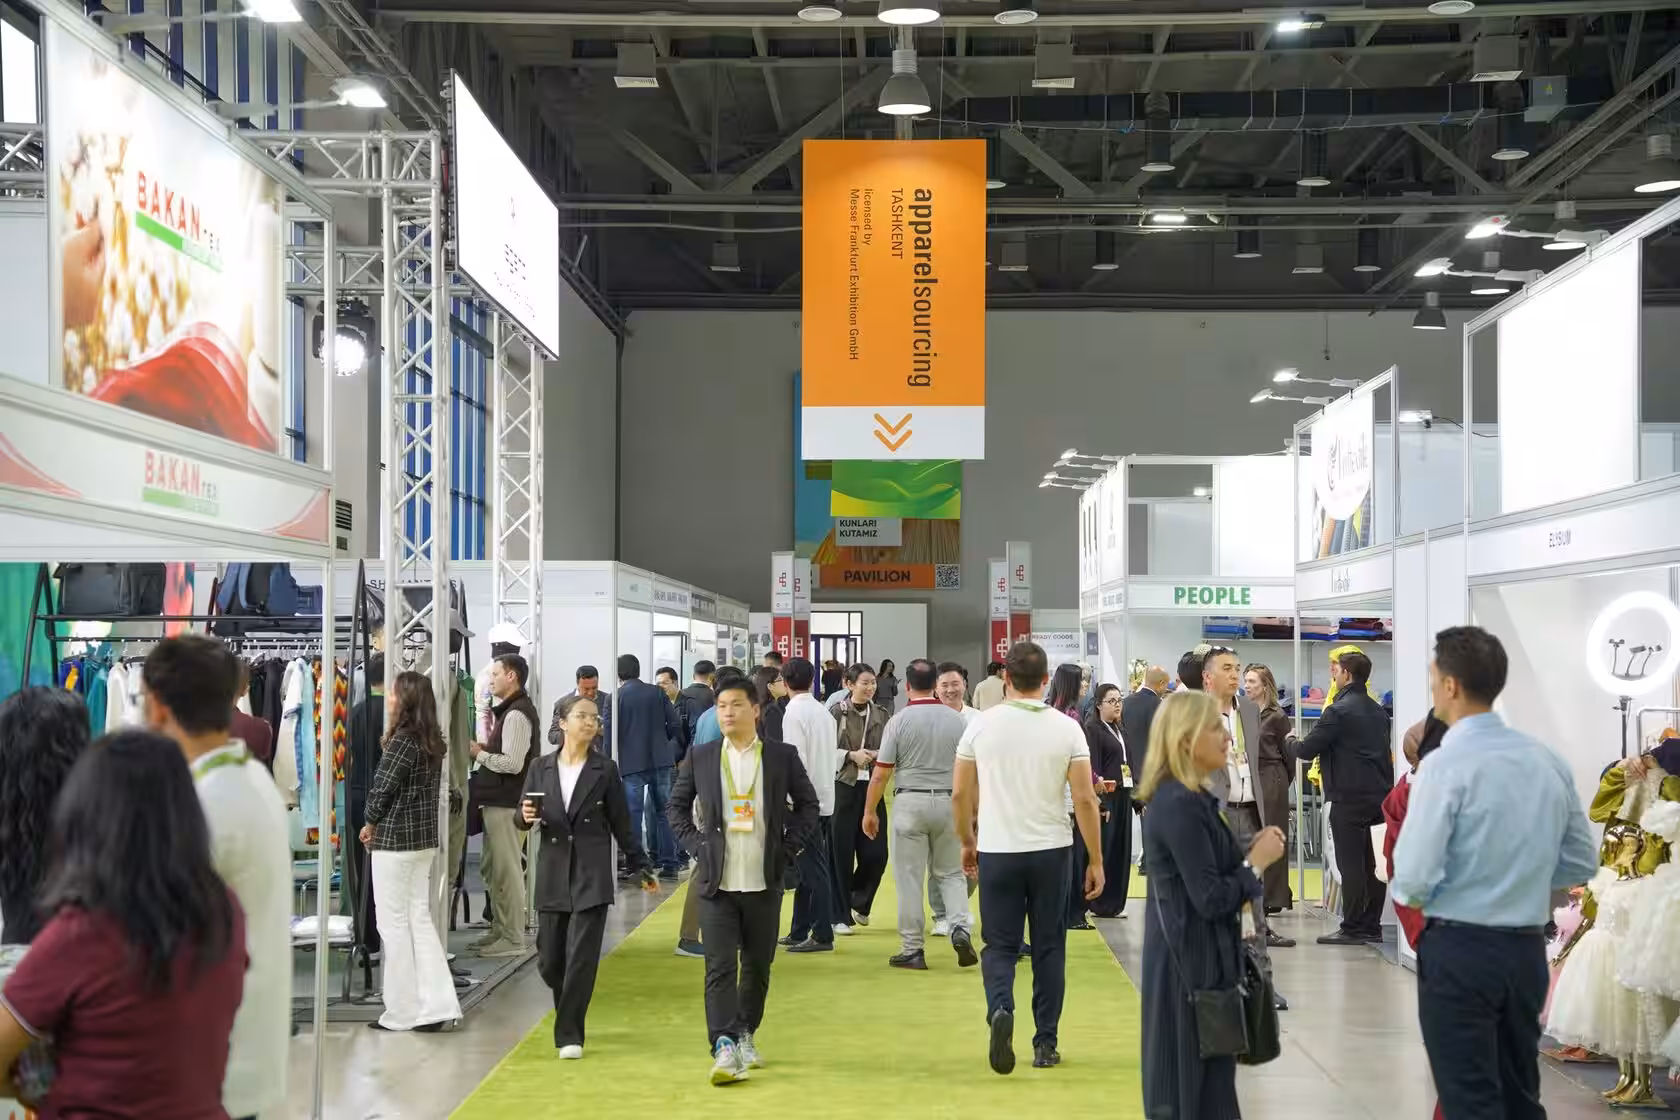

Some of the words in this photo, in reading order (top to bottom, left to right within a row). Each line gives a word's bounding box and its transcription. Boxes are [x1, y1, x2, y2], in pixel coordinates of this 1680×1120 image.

[849, 188, 860, 222] Messe
[863, 188, 874, 230] licensed
[861, 233, 872, 246] by
[892, 188, 903, 259] TASHKENT
[849, 225, 859, 272] Frankfurt
[849, 275, 859, 326] Exhibition
[907, 188, 938, 386] apparelsourcing
[849, 328, 859, 361] GmbH
[839, 519, 877, 528] KUNLARI
[839, 529, 878, 538] KUTAMIZ
[844, 569, 911, 583] PAVILION
[1174, 586, 1251, 605] PEOPLE
